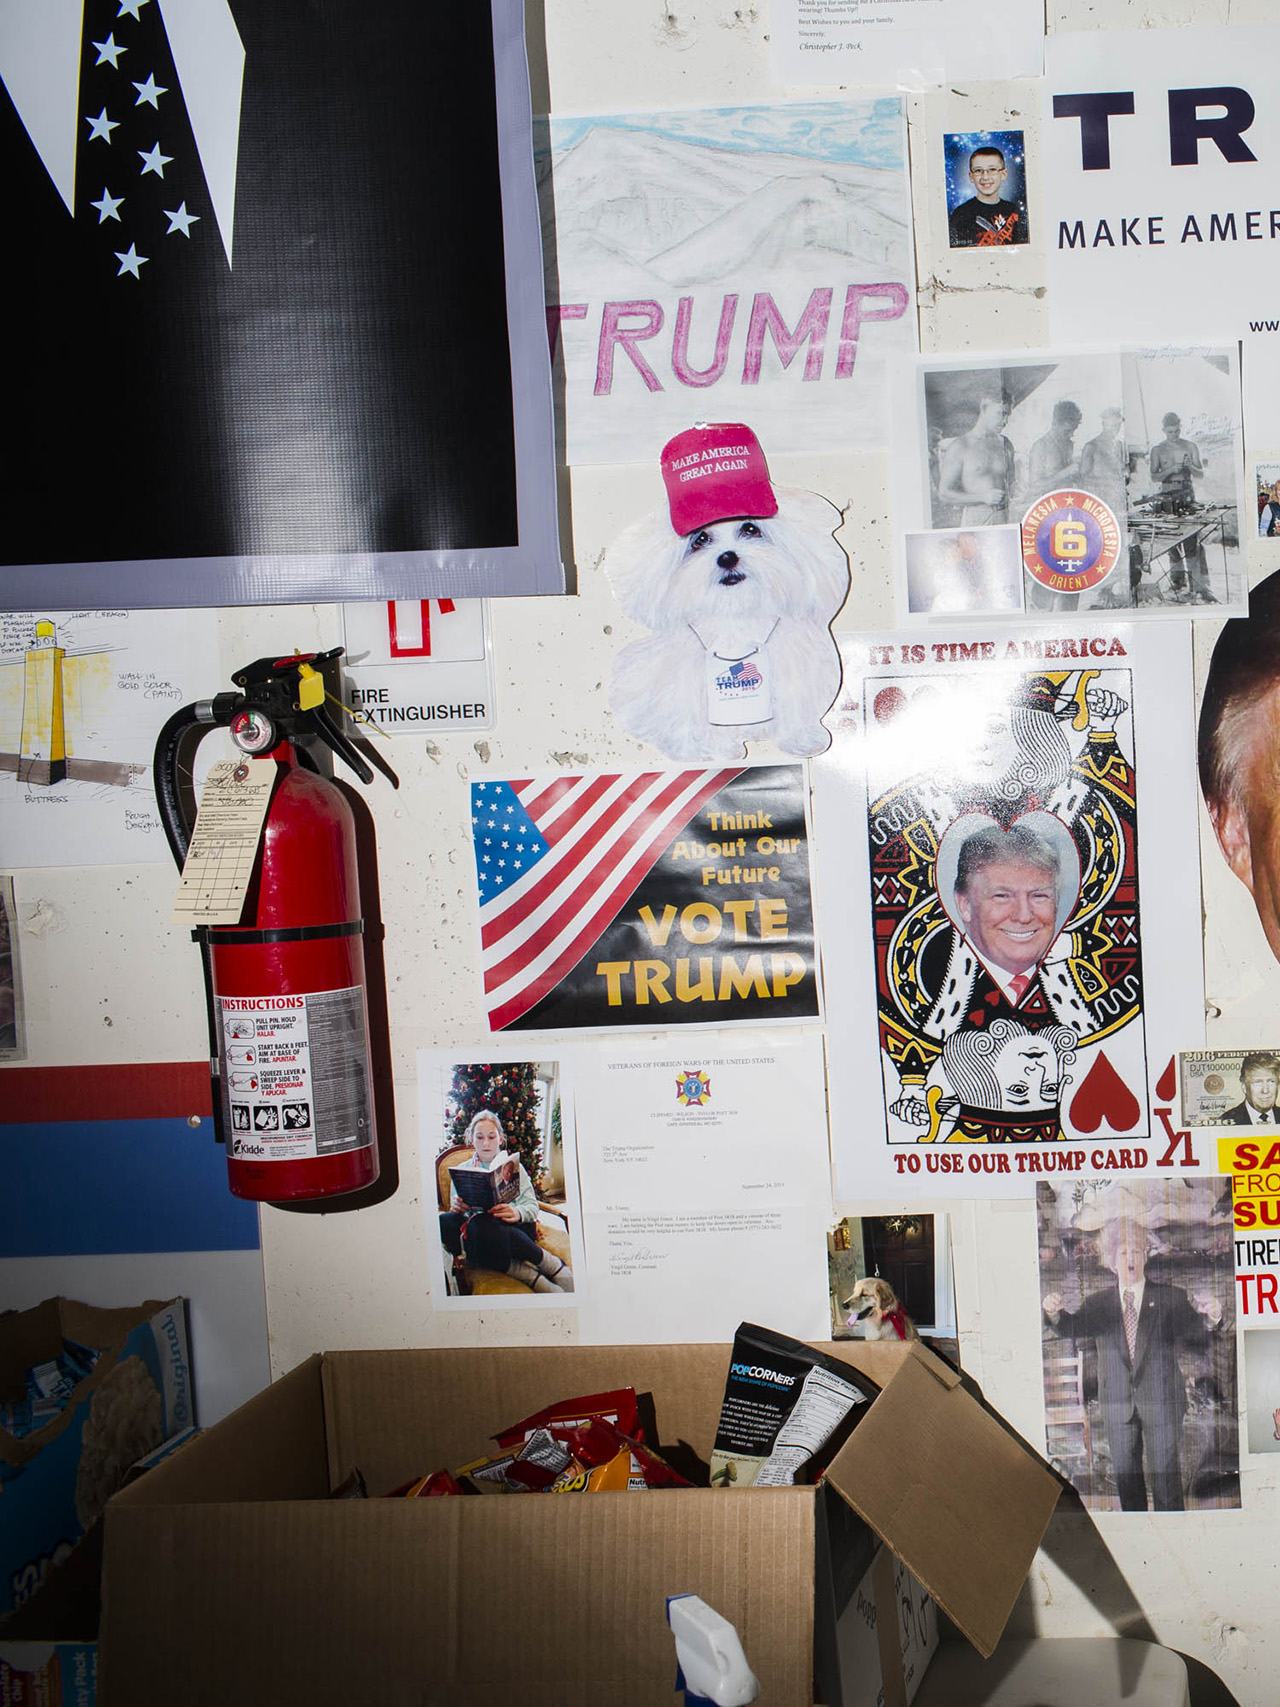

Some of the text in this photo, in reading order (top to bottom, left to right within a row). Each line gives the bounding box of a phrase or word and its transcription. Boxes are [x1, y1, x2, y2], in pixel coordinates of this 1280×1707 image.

[799, 42, 837, 52] Christopher
[1058, 216, 1165, 249] MAKE
[671, 445, 750, 471] MAKE AMERICA
[679, 459, 748, 482] GREAT AGAIN
[1023, 498, 1059, 557] MELANESIA
[1082, 498, 1118, 558] MICRONESIA
[1050, 520, 1087, 560] 6
[1049, 574, 1090, 589] ORIENT
[868, 637, 1127, 665] IT IS TIME AMERICA
[716, 675, 738, 684] TEAM
[717, 679, 759, 690] TRUMP
[351, 689, 389, 704] FIRE
[353, 704, 485, 724] EXTINGUISHER
[706, 810, 773, 831] Think
[672, 836, 801, 860] About Our
[702, 866, 781, 885] Future
[637, 898, 789, 947] VOTE
[596, 952, 807, 1006] TRUMP
[222, 997, 304, 1010] INSTRUCTIONS
[241, 1145, 264, 1154] Kidde
[894, 1148, 1148, 1174] TO USE OUR TRUMP CARD
[161, 1314, 190, 1424] Original
[731, 1363, 797, 1386] POPCORNERS
[814, 1369, 840, 1385] Nutrition
